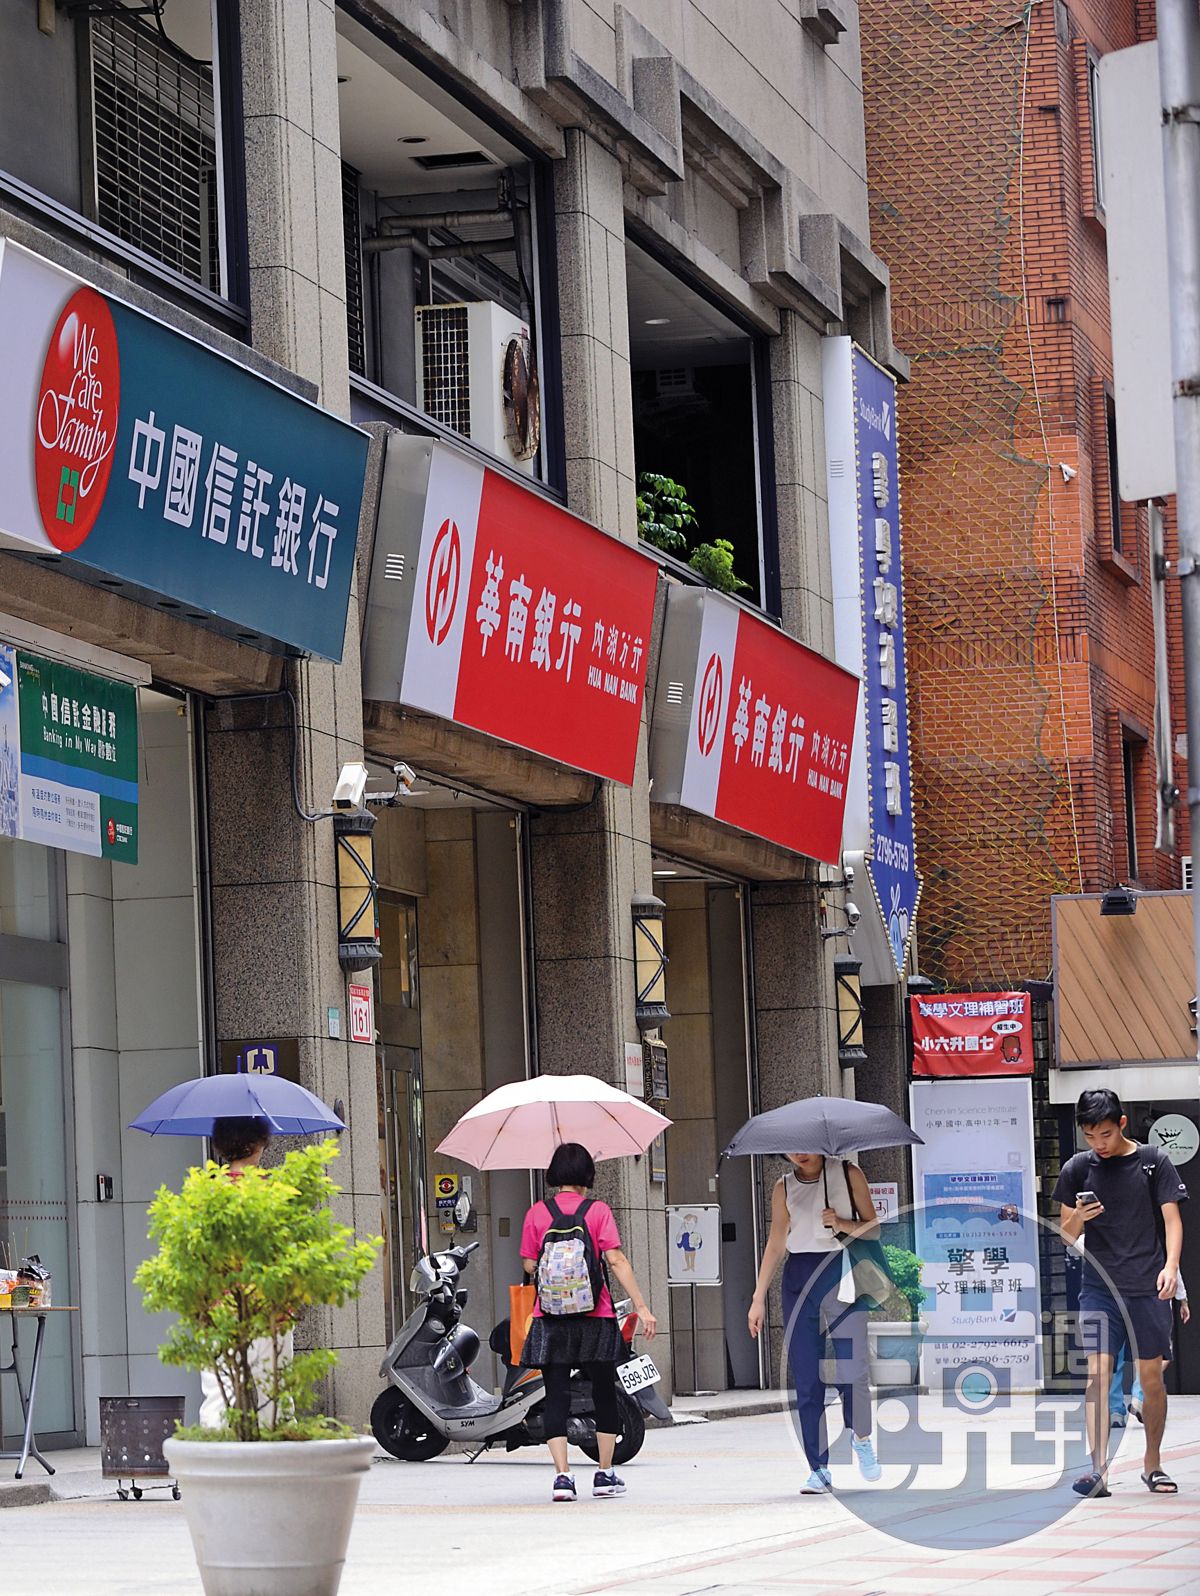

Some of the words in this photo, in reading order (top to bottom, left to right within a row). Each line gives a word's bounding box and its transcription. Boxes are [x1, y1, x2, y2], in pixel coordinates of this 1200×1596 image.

[73, 319, 99, 379] We
[128, 411, 340, 590] 中國信託銀行
[475, 549, 582, 683] 華南銀行
[587, 664, 602, 690] HUA
[603, 672, 619, 696] NAN
[619, 679, 638, 705] BANK
[65, 732, 73, 748] in
[84, 738, 97, 757] Way
[732, 675, 804, 784] 華南銀行
[806, 768, 818, 789] HUA
[818, 773, 830, 794] NAN
[829, 779, 844, 800] BANK
[876, 833, 910, 873] 2796-5759
[353, 1007, 369, 1033] 161
[921, 1035, 995, 1052] 小六升國七
[946, 1246, 1010, 1277] 擎學
[936, 1278, 1023, 1295] 文理補習班
[951, 1339, 1030, 1351] 02-2792-6615
